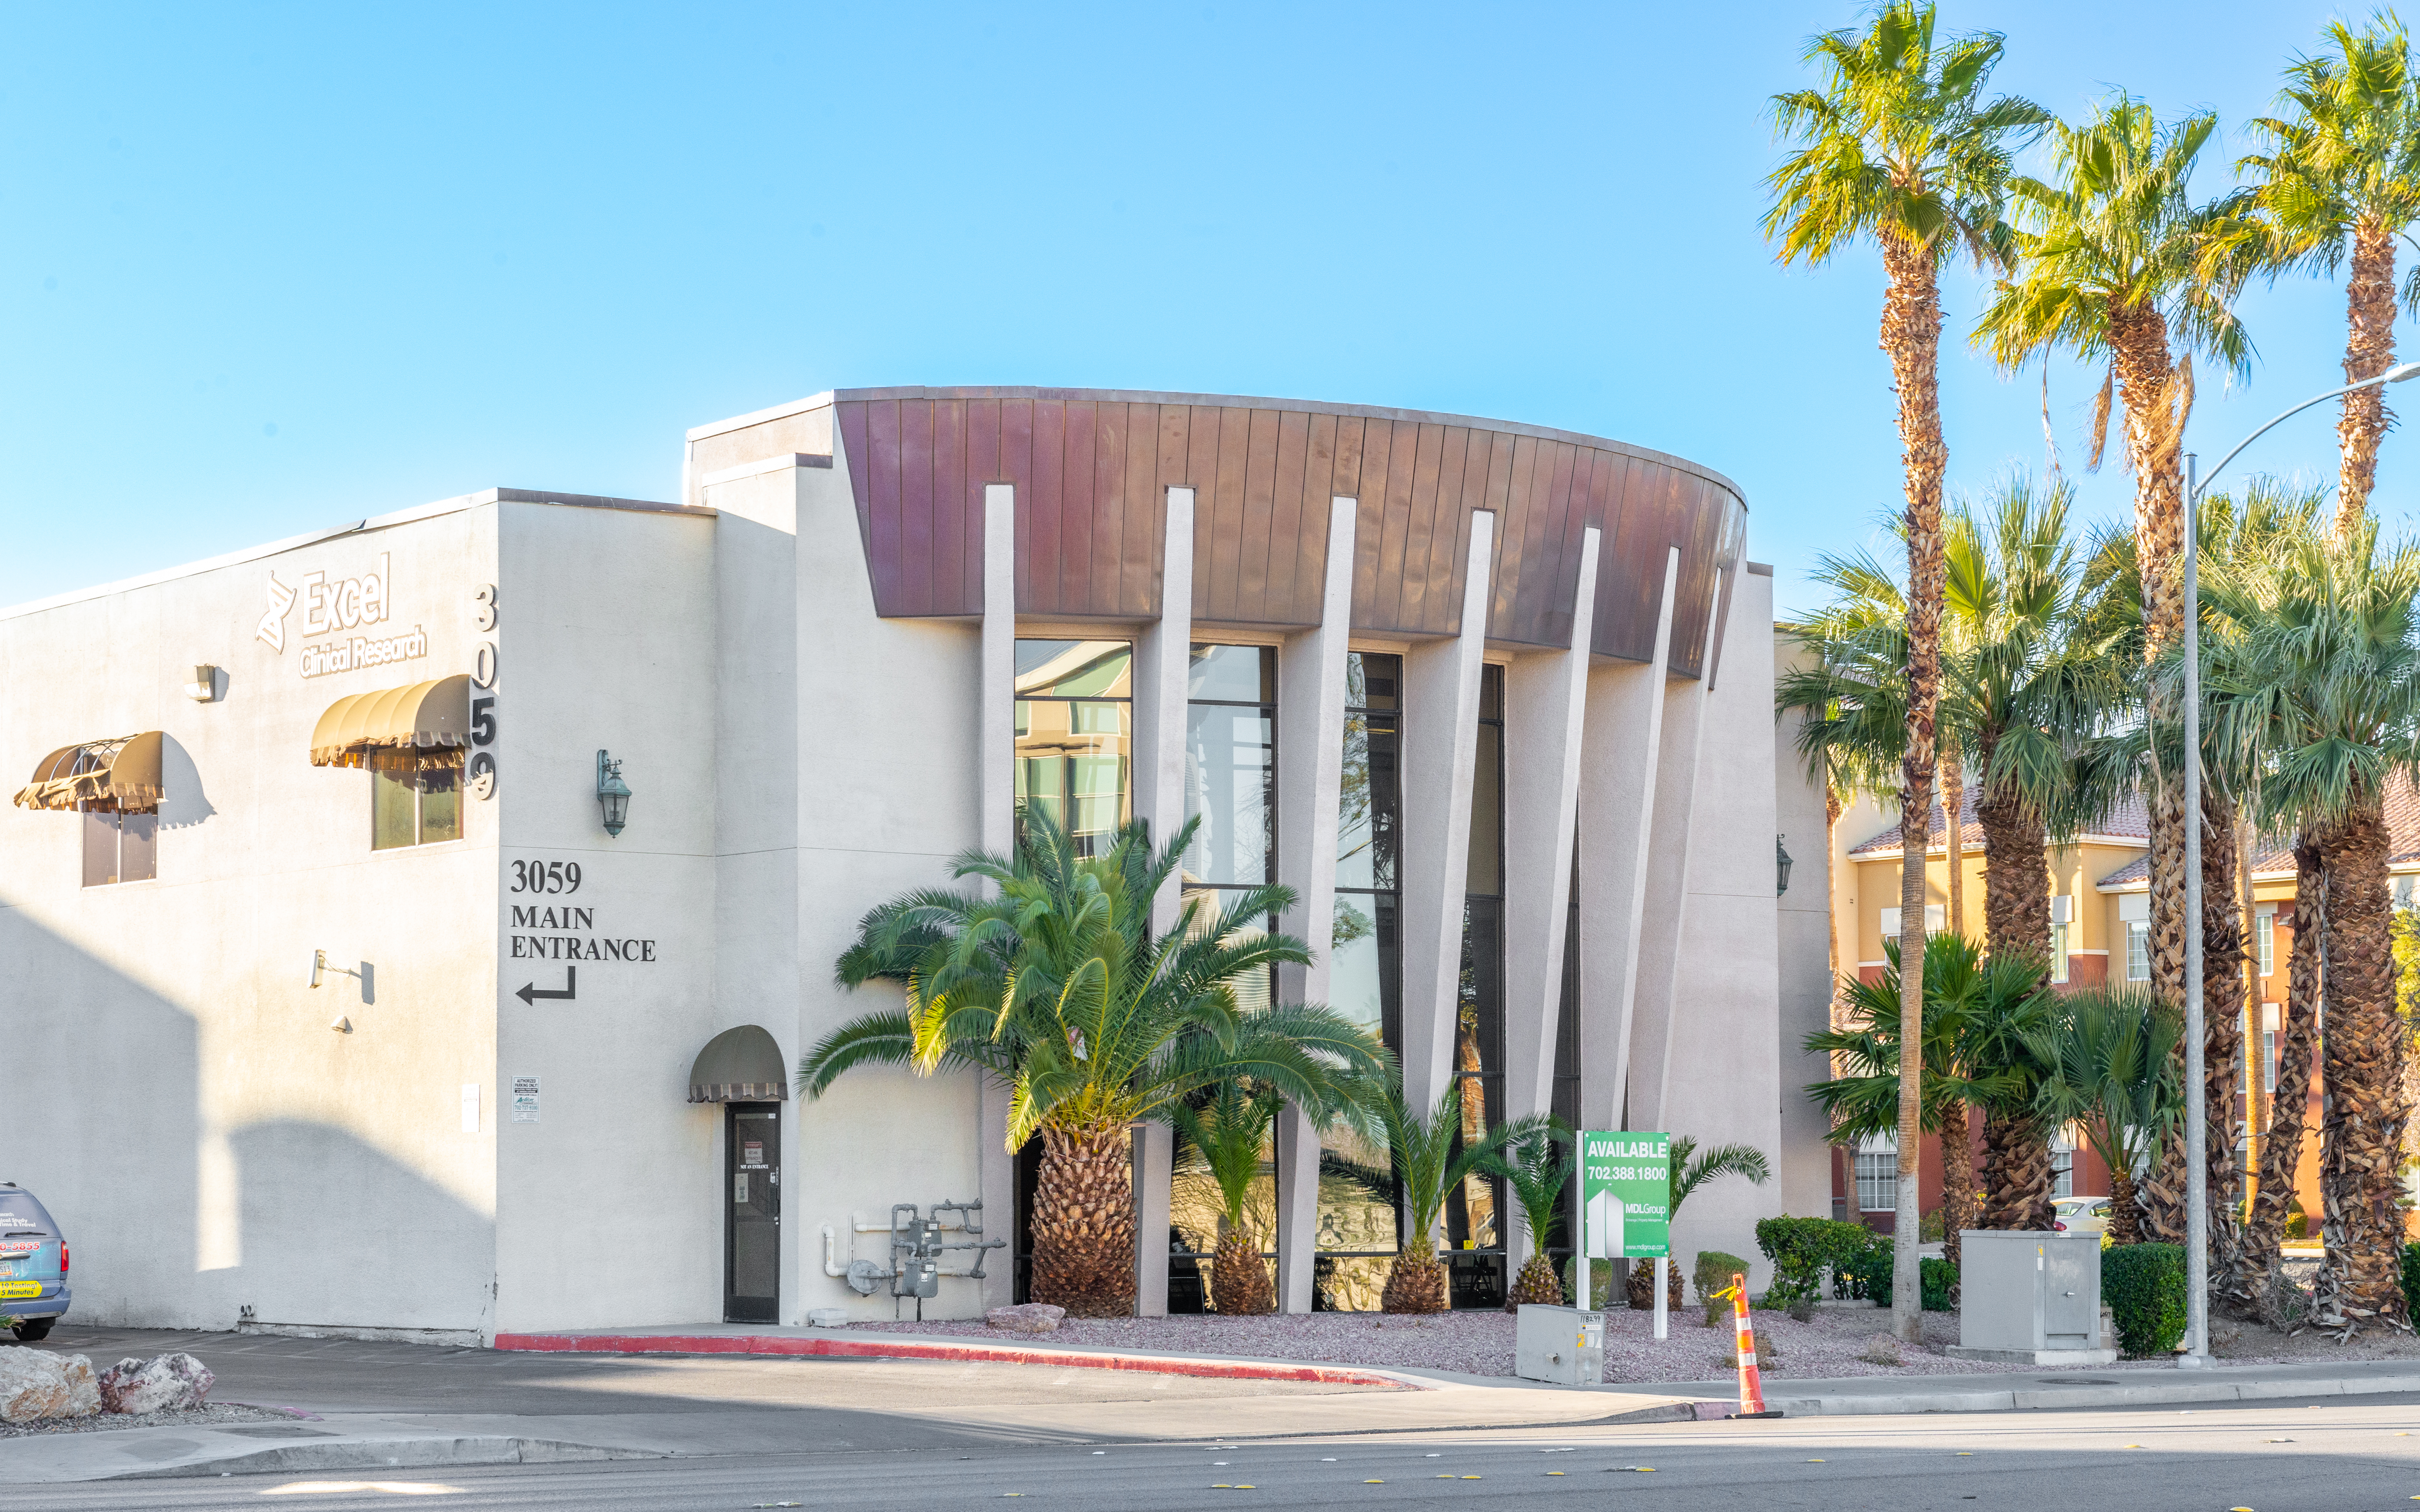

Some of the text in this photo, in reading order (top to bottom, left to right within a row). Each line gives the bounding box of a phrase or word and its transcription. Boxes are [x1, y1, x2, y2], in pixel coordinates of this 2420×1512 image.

[302, 551, 389, 638] Excel
[299, 624, 427, 679] Clinical Research
[470, 583, 496, 800] 3059
[510, 860, 581, 894] 3059
[510, 905, 595, 929] MAIN
[510, 936, 656, 961] ENTRANCE
[1588, 1141, 1667, 1158] AVAILABLE
[1588, 1166, 1667, 1180] 702.388.1800
[1626, 1204, 1666, 1217] MDLGroup
